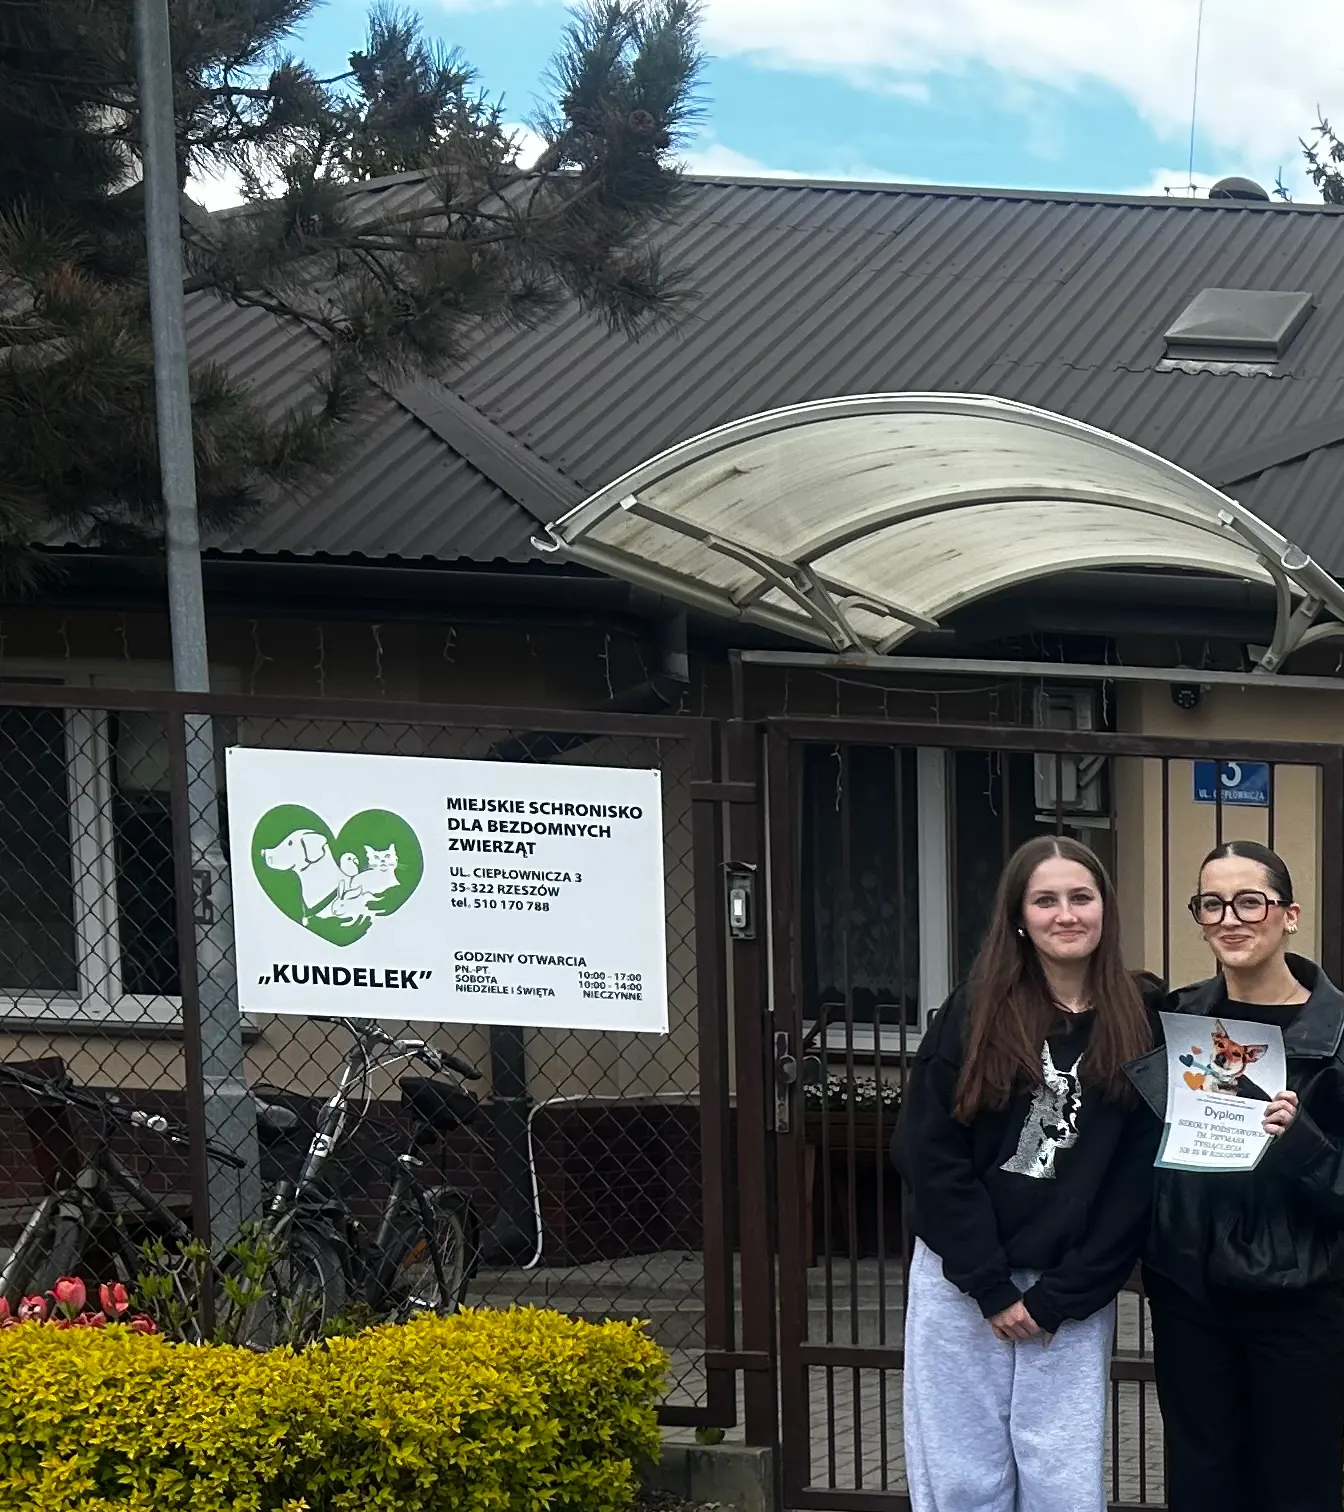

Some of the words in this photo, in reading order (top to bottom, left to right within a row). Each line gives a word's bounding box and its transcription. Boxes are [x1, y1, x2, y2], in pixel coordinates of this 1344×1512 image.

[1213, 789, 1265, 800] CEPŁOWNICZA
[447, 797, 525, 814] MIEJSKIE
[529, 801, 643, 819] SCHRONISKO
[447, 818, 483, 832] DLA
[487, 819, 611, 838] BEZDOMNYCH
[448, 838, 536, 858] ZWIERZĄT
[450, 867, 471, 878] UL.
[473, 868, 572, 883] CIEPŁOWNICZA
[575, 873, 582, 883] 3
[451, 882, 494, 894] 35-322
[497, 884, 560, 897] RZESZÓW
[451, 897, 471, 909] tel.
[474, 899, 497, 909] 510
[501, 900, 524, 911] 170
[526, 901, 550, 912] 788
[454, 951, 515, 964] GODZINY
[517, 954, 588, 968] OTWARCIA
[455, 974, 498, 985] SOBOTA
[578, 971, 606, 981] 10:00
[614, 973, 642, 982] 17:00
[455, 984, 509, 995] NIEDZIELE
[516, 985, 555, 998] ŚWIĘTA
[578, 980, 606, 990] 10:00
[614, 982, 642, 991] 14:00
[583, 989, 643, 1001] NIECZYNNE
[1205, 1106, 1245, 1122] Dyplom
